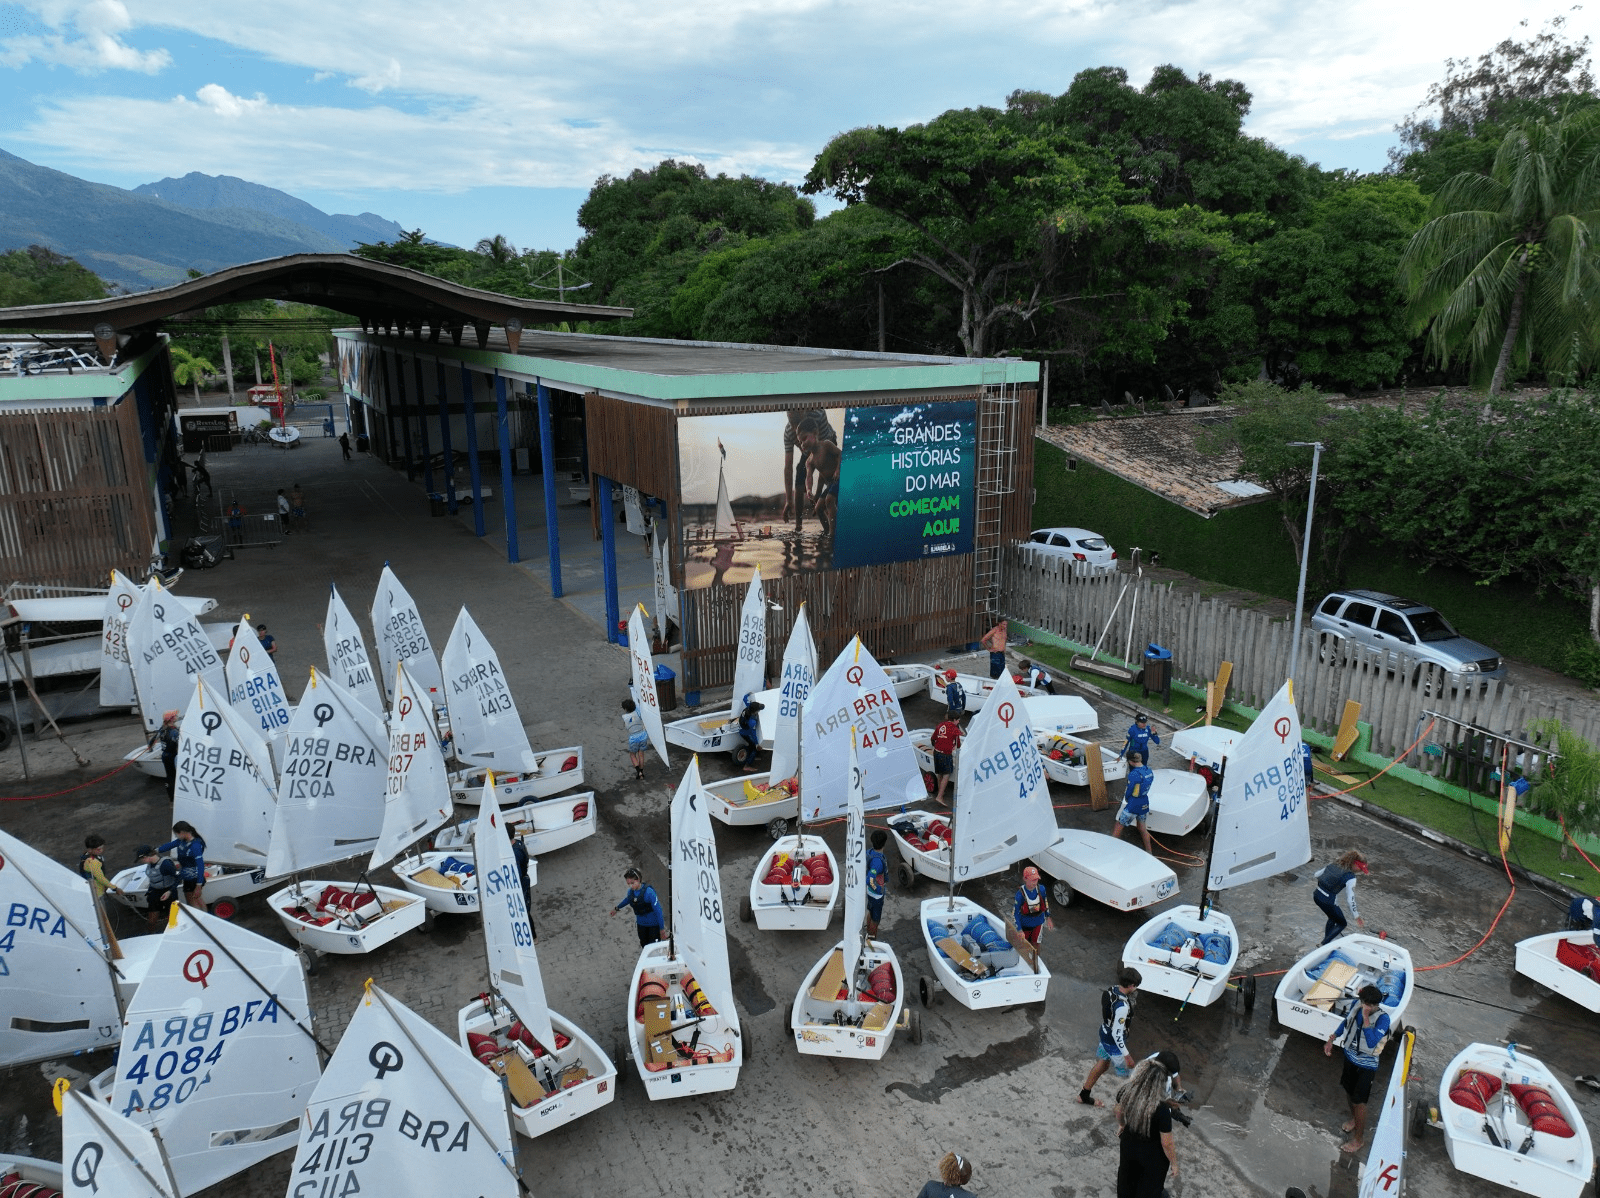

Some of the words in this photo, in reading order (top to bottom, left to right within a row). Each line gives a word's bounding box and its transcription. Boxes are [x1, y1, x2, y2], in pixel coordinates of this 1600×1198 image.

[894, 423, 961, 445] GRANDES
[891, 447, 961, 470] HISTÓRIAS
[906, 474, 927, 492] DO
[930, 471, 960, 490] MAR
[889, 495, 960, 518] COMEÇAM
[391, 608, 418, 631] BRA
[163, 622, 200, 649] BRA
[336, 636, 362, 659] BRA
[395, 636, 429, 662] 3582
[185, 650, 217, 675] 4115
[470, 659, 500, 684] BRA
[246, 672, 278, 698] BRA
[348, 667, 372, 689] 4411
[481, 694, 512, 718] 4413
[853, 689, 893, 717] BRA
[262, 708, 289, 730] 4118
[862, 721, 904, 749] 4175
[1009, 725, 1033, 761] BRA
[335, 743, 377, 767] BRA
[389, 754, 413, 774] 4137
[1284, 741, 1302, 776] BRA
[180, 757, 226, 785] 4172
[286, 758, 333, 778] 4021
[1020, 760, 1042, 799] 4315
[1281, 778, 1305, 821] 4099
[6, 903, 67, 939] BRA
[126, 1039, 226, 1085] 4084
[399, 1109, 470, 1153] BRA
[299, 1132, 375, 1175] 4113
